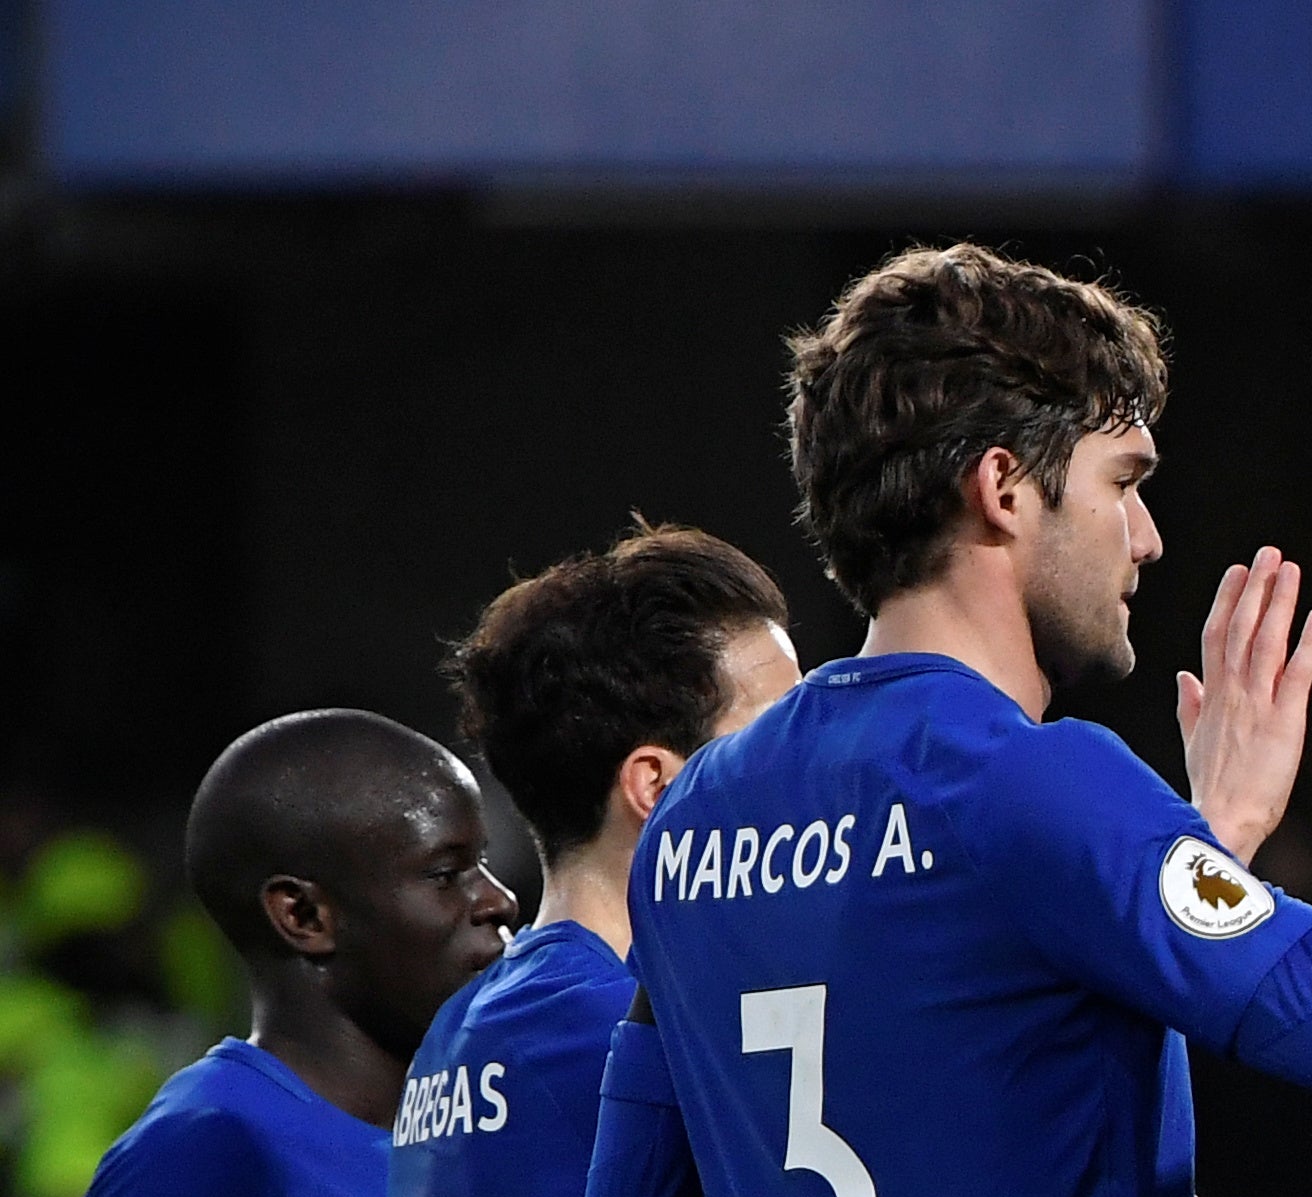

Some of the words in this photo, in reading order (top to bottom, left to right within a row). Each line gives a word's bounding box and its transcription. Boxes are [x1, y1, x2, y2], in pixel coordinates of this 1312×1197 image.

[654, 814, 856, 902] MARCOS
[872, 803, 934, 877] A.
[1181, 905, 1215, 928] Premier
[1217, 909, 1252, 928] League
